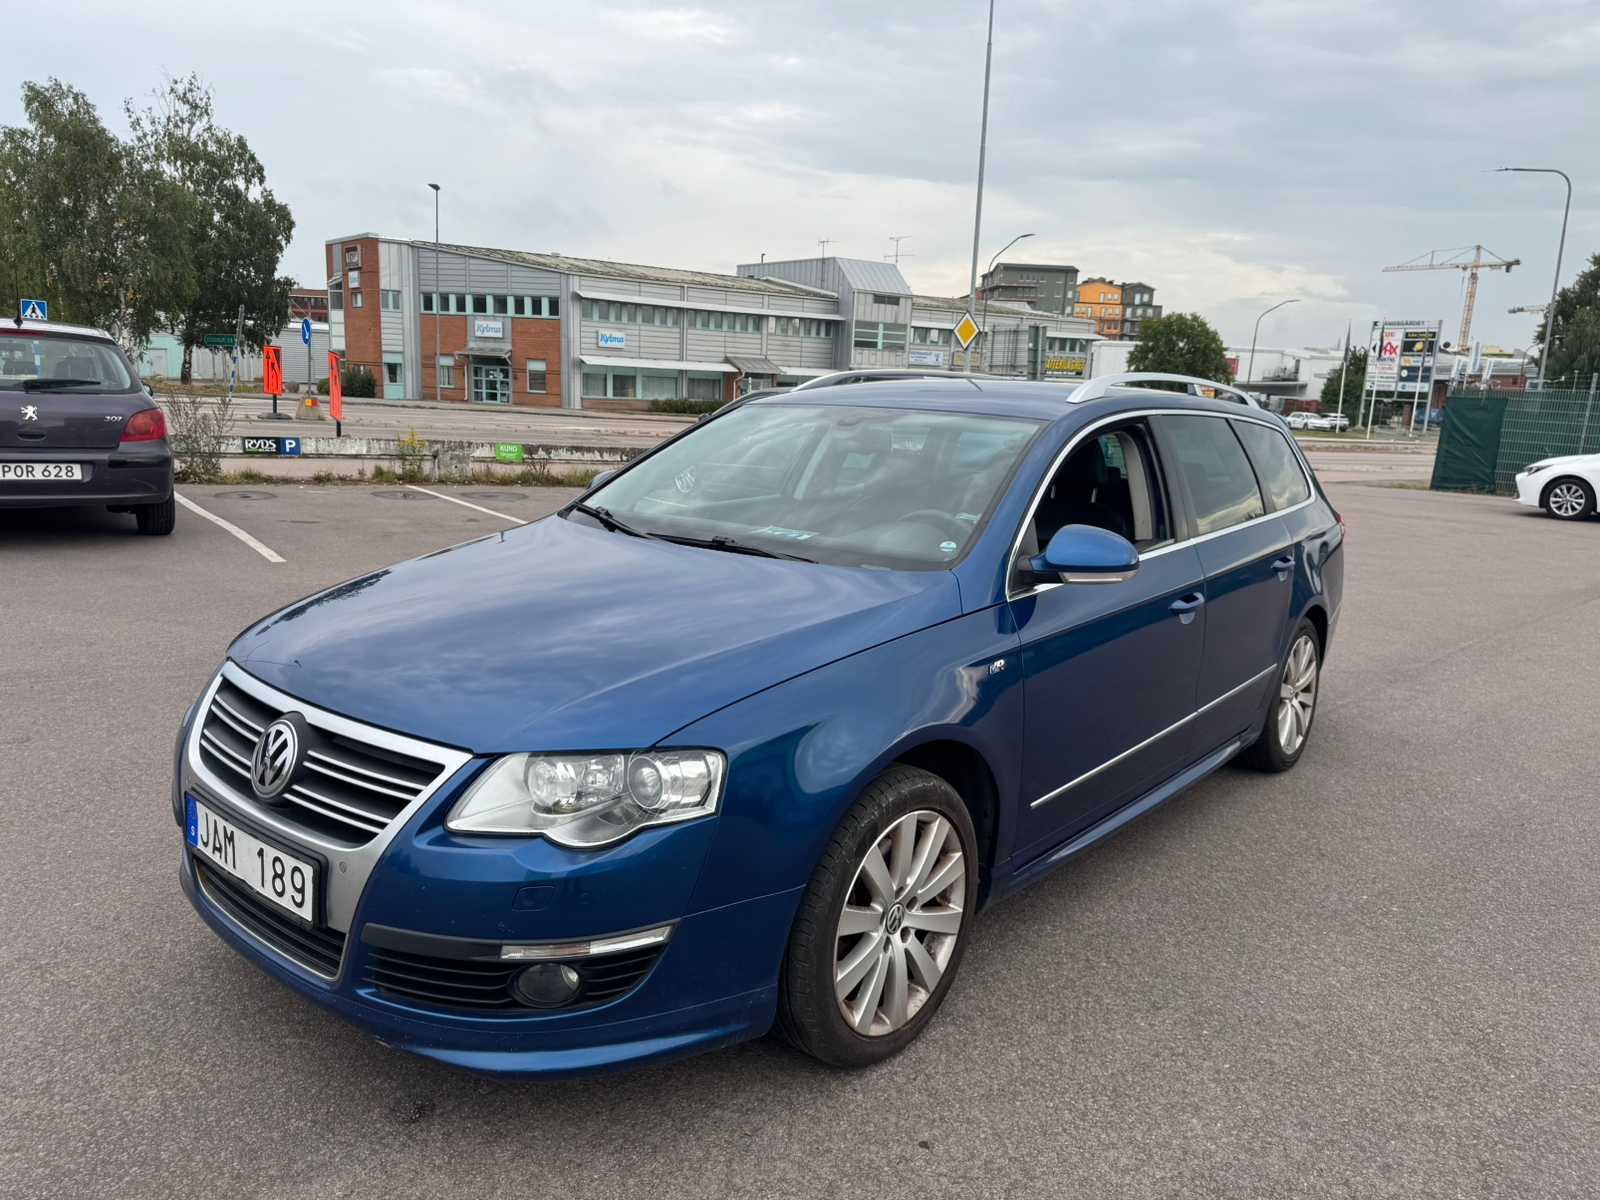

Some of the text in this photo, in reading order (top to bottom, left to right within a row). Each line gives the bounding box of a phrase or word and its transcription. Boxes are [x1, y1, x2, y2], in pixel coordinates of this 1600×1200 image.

[476, 324, 500, 334] Kylma
[600, 334, 624, 344] Kylma
[245, 439, 276, 449] RYDS
[286, 440, 296, 452] P
[2, 464, 75, 478] POR 628
[200, 811, 306, 908] JAM 189
